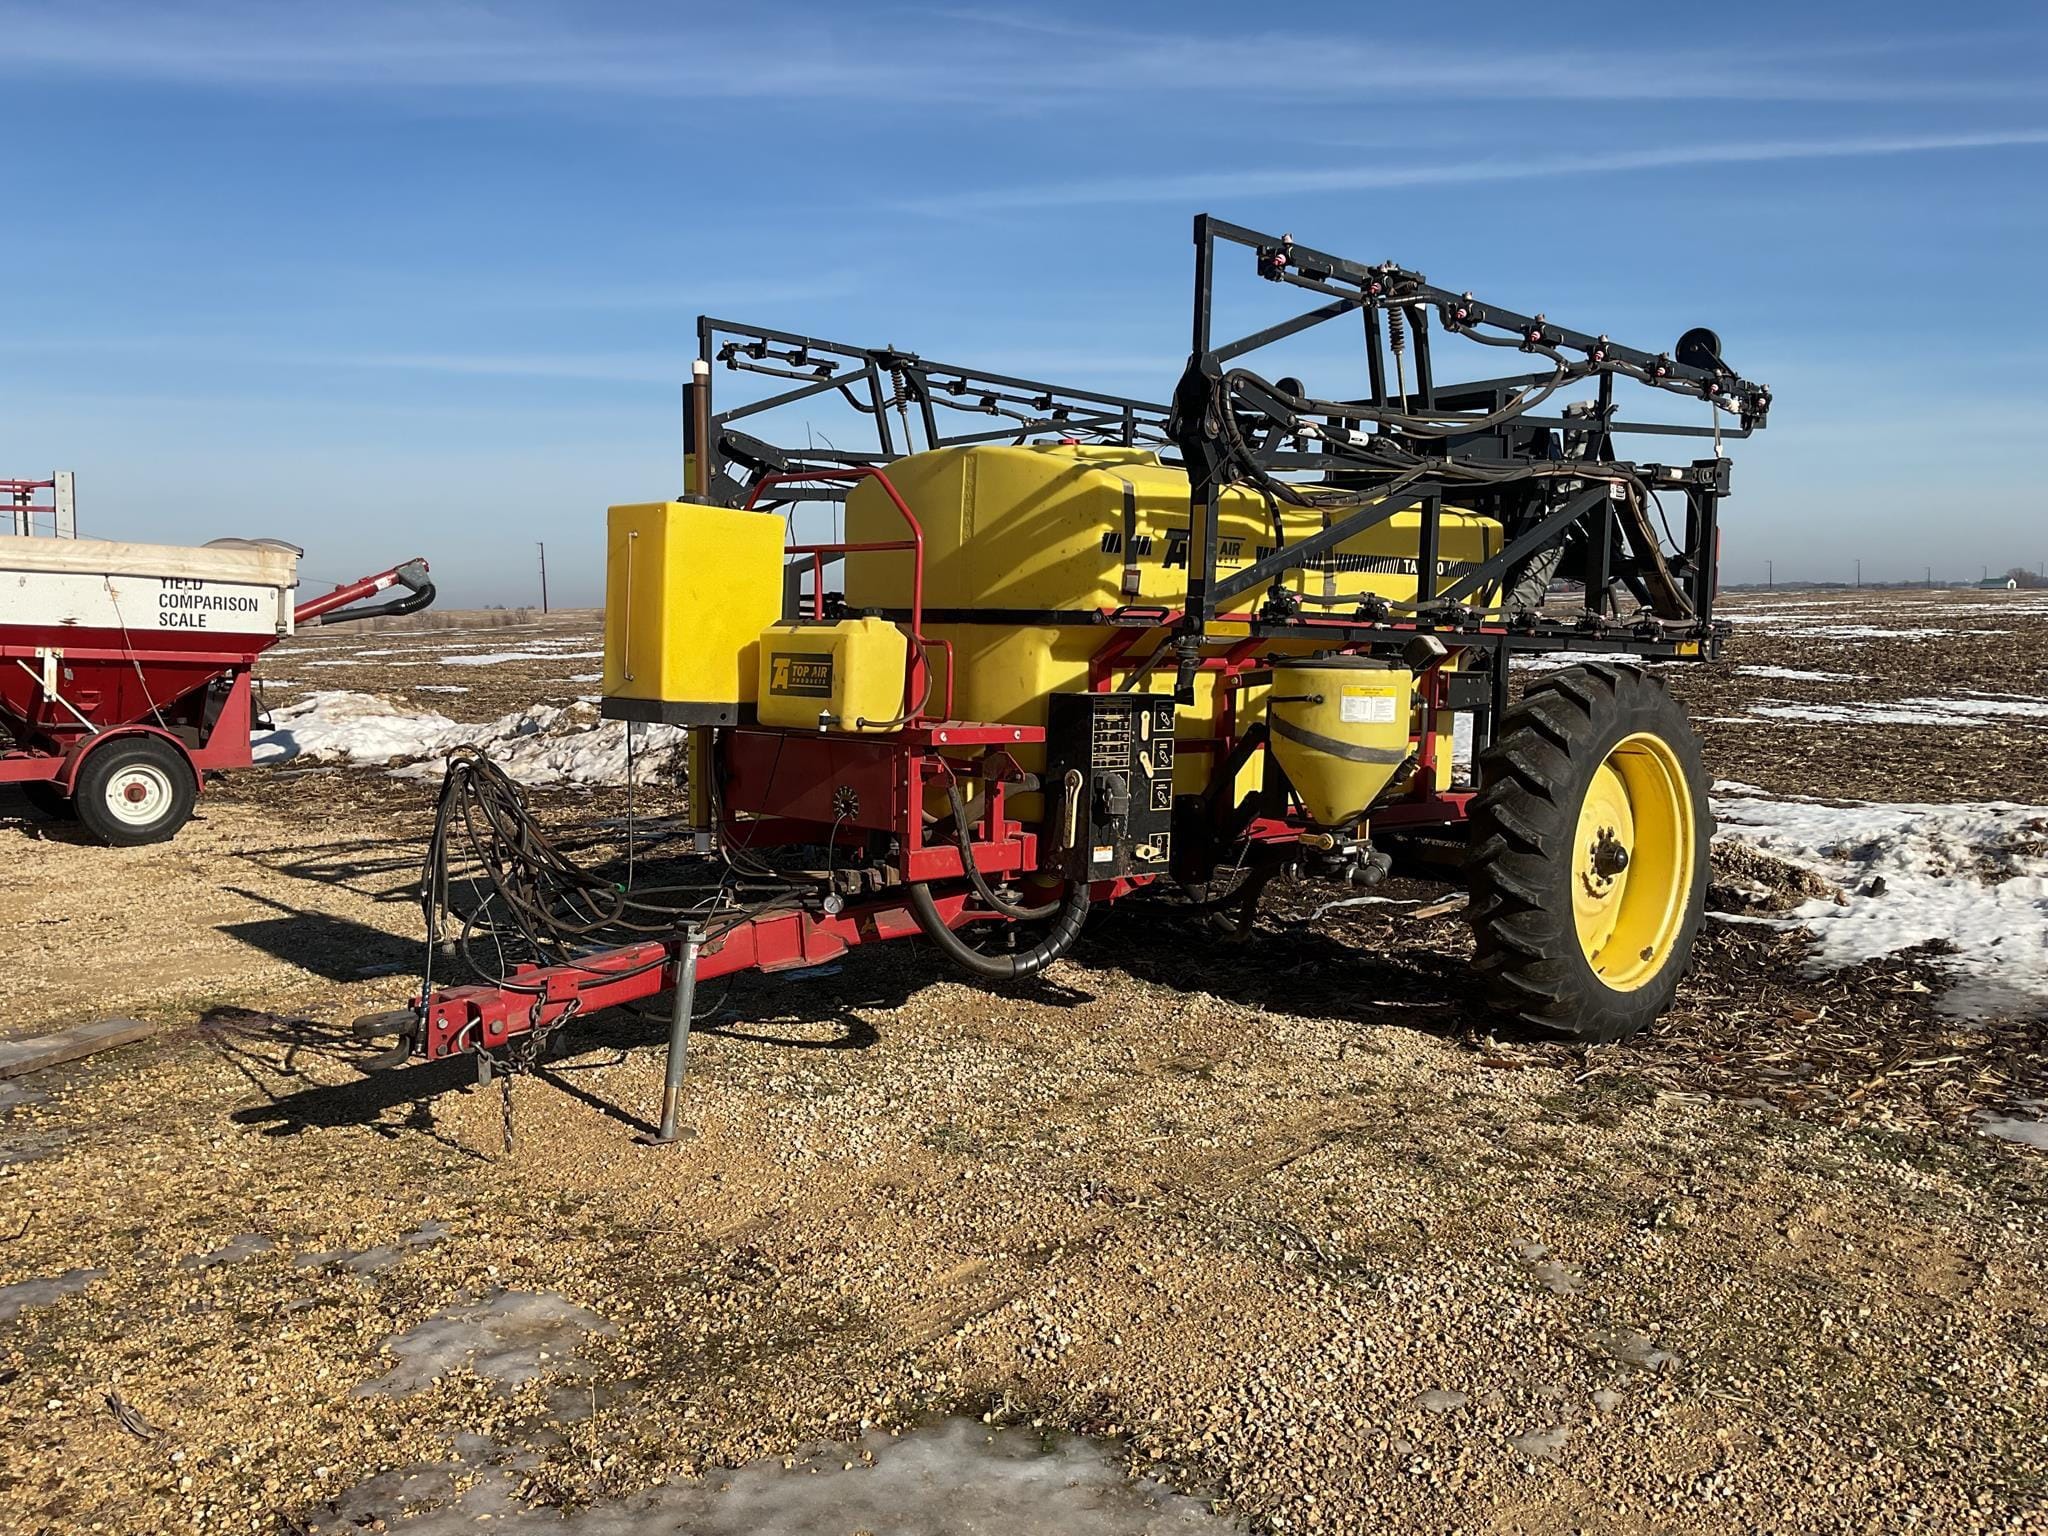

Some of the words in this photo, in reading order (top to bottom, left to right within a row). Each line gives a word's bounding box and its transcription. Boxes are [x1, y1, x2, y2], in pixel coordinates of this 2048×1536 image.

[1219, 541, 1240, 556] AIR
[159, 577, 203, 591] YIELD
[159, 593, 258, 612] COMPARISON
[159, 611, 207, 628] SCALE
[792, 665, 810, 677] TOP
[811, 666, 828, 678] AIR
